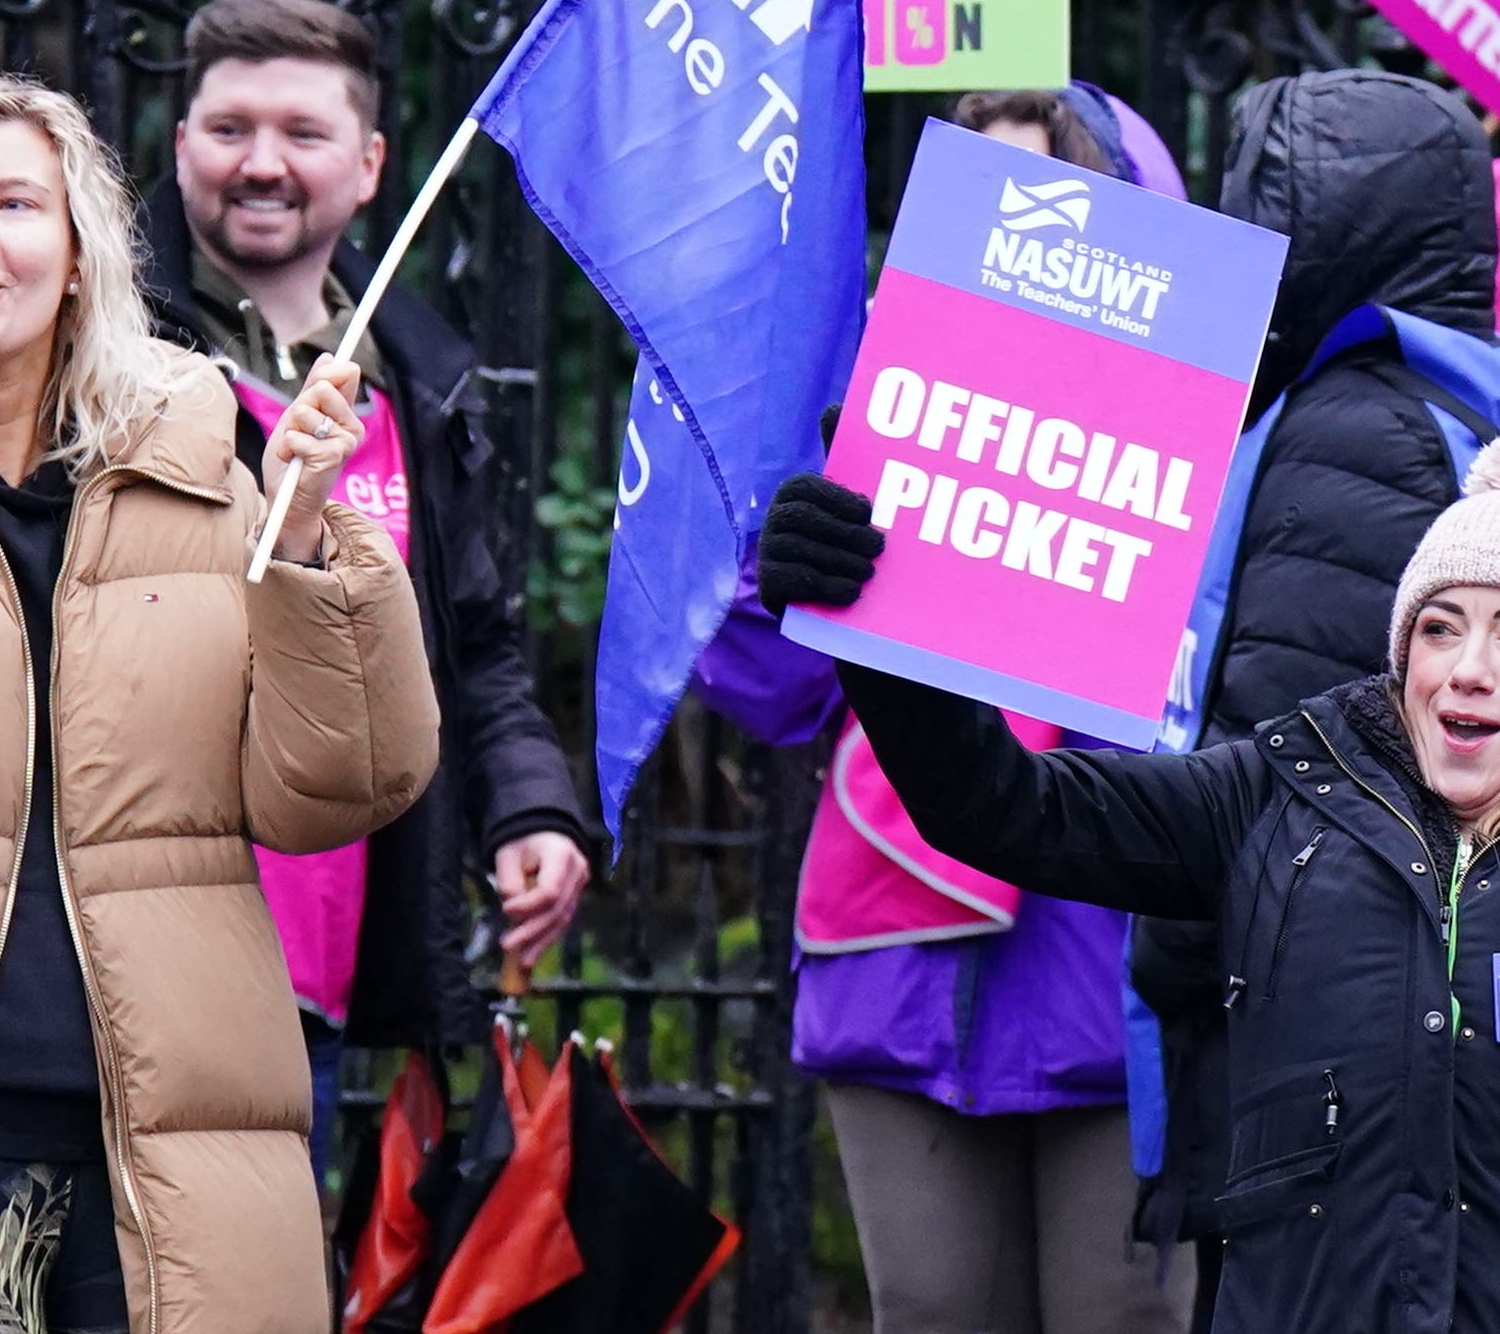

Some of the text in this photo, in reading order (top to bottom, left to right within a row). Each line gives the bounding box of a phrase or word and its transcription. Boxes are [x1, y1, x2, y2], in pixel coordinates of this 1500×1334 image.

[737, 73, 798, 245] Te
[980, 269, 1150, 338] The Teachers' Union
[981, 228, 1168, 320] NASUWT
[1062, 238, 1172, 283] SCOTLAND
[866, 366, 1193, 531] OFFICIAL
[870, 458, 1151, 603] PICKET
